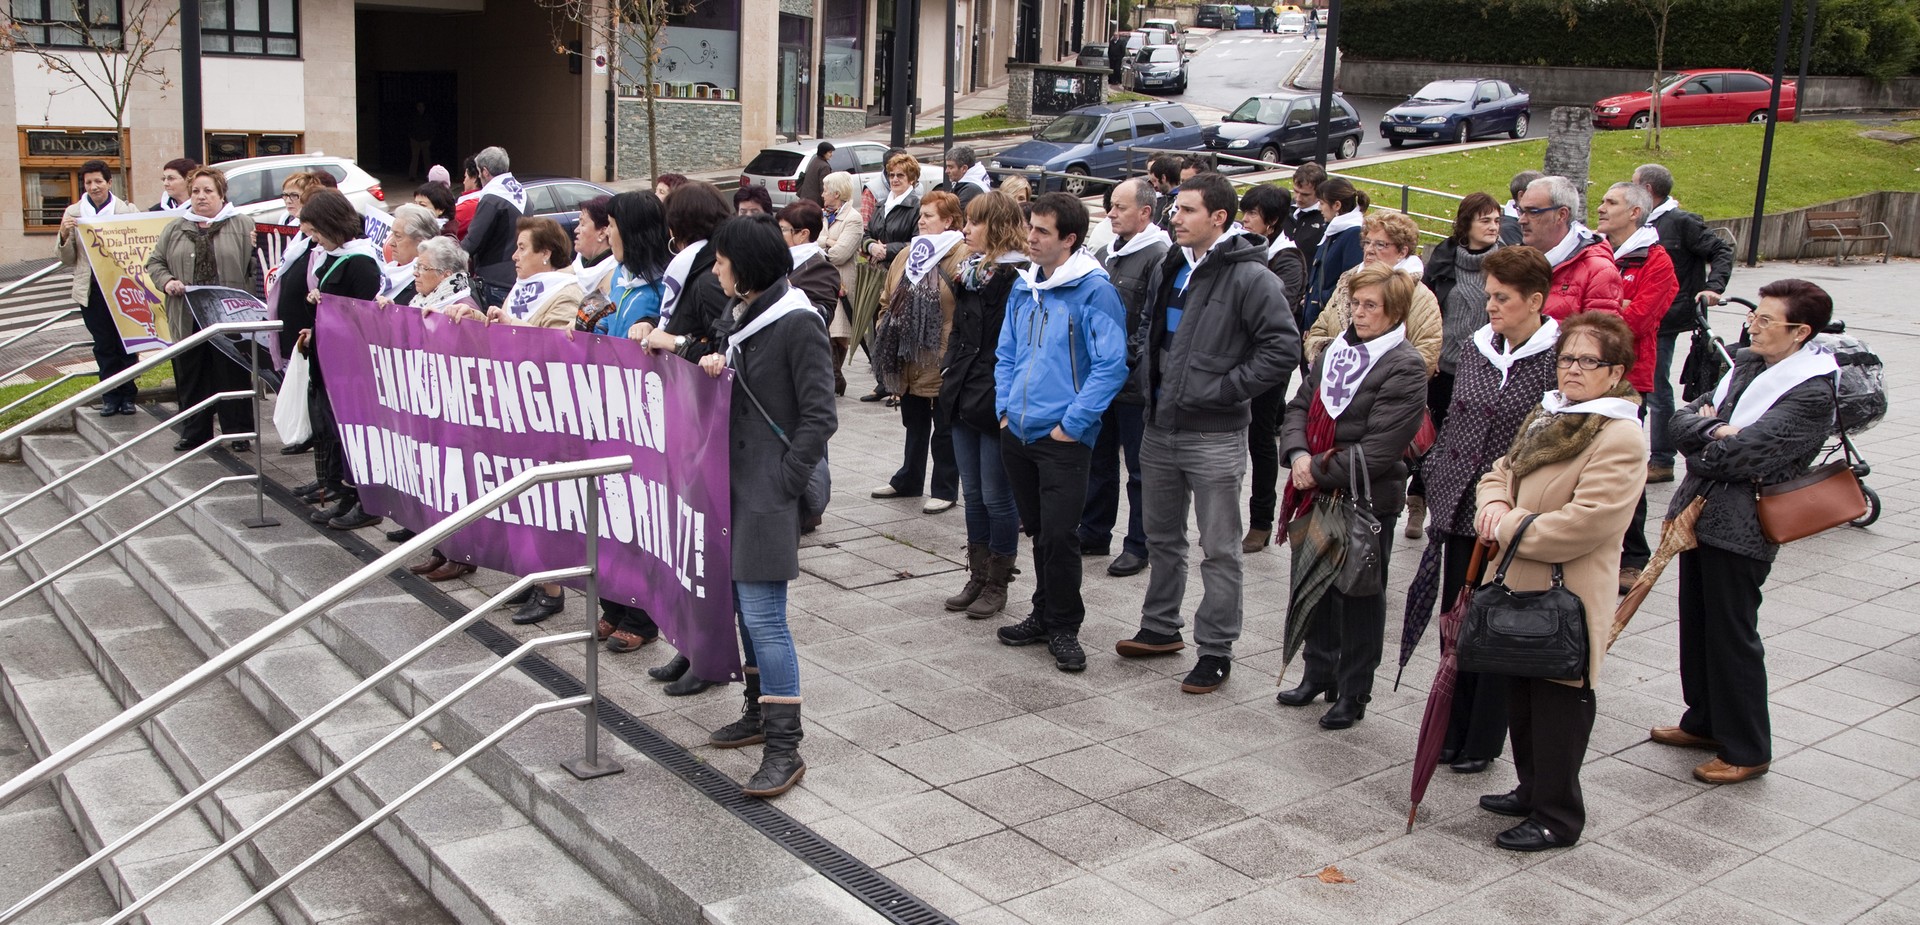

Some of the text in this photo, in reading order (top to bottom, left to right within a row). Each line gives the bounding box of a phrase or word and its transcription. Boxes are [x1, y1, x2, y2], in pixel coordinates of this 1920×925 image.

[41, 139, 107, 151] PINTXOS
[86, 226, 137, 248] 25 noviembre
[119, 287, 147, 306] STOP
